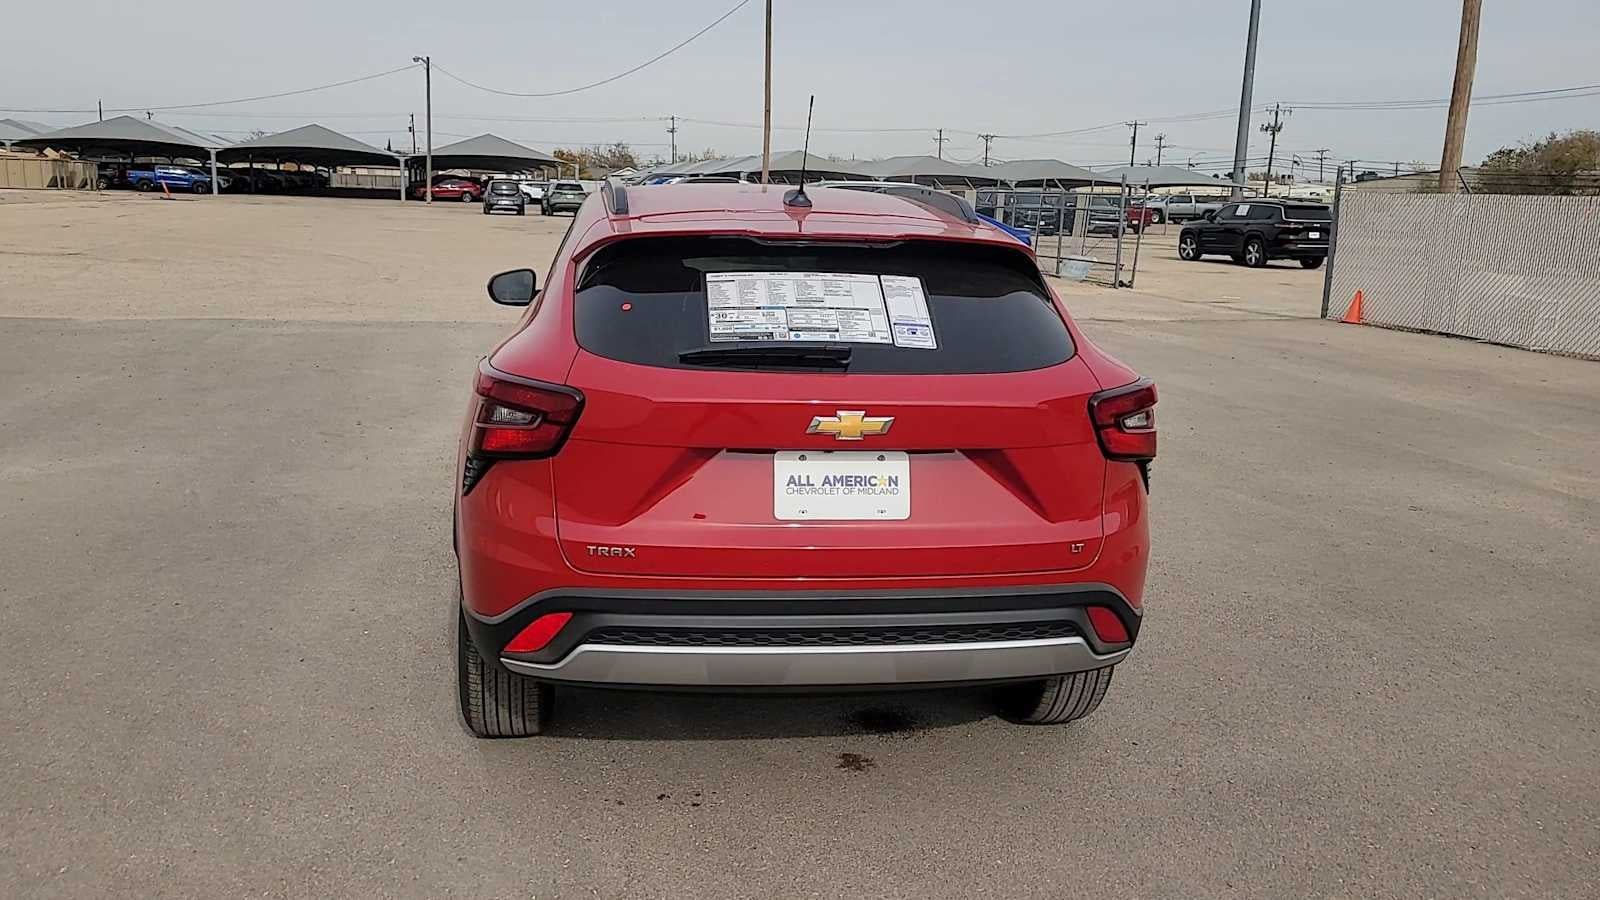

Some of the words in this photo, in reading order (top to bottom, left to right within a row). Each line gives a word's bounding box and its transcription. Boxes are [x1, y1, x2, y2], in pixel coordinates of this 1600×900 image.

[786, 475, 815, 487] ALL
[786, 487, 840, 495] CHEVROLET
[842, 487, 856, 495] OF
[857, 487, 899, 495] MIDLAND
[587, 546, 635, 557] TRAX
[1072, 544, 1084, 552] LT
